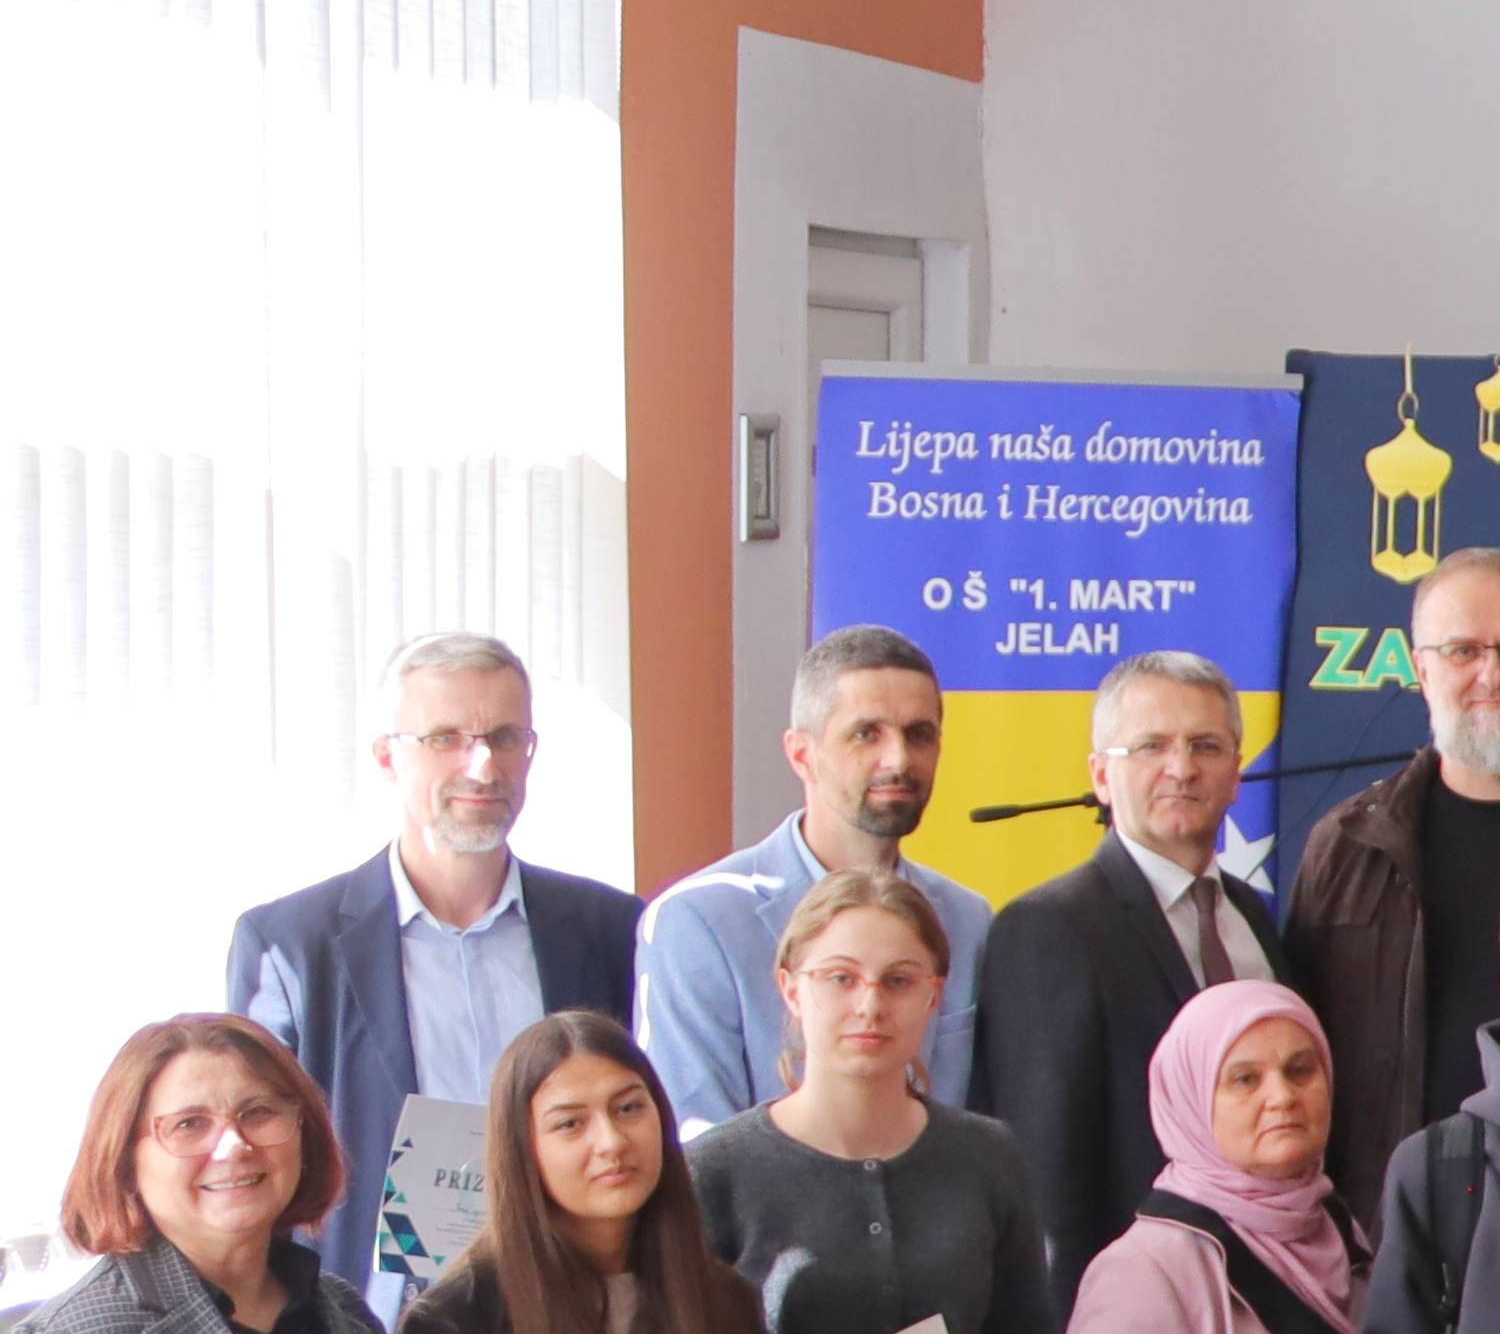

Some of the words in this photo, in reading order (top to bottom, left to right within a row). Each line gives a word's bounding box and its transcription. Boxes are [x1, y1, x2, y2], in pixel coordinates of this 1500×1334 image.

[855, 420, 979, 474] Lijepa
[989, 424, 1076, 461] naša
[1085, 420, 1265, 465] domovina
[867, 481, 987, 519] Bosna
[998, 483, 1013, 520] i
[1023, 485, 1253, 538] Hercegovina
[1010, 578, 1058, 610] "1.
[1069, 579, 1196, 611] MART"
[996, 623, 1119, 655] JELAH
[1309, 626, 1420, 692] ZA
[433, 1167, 485, 1194] PRIZ
